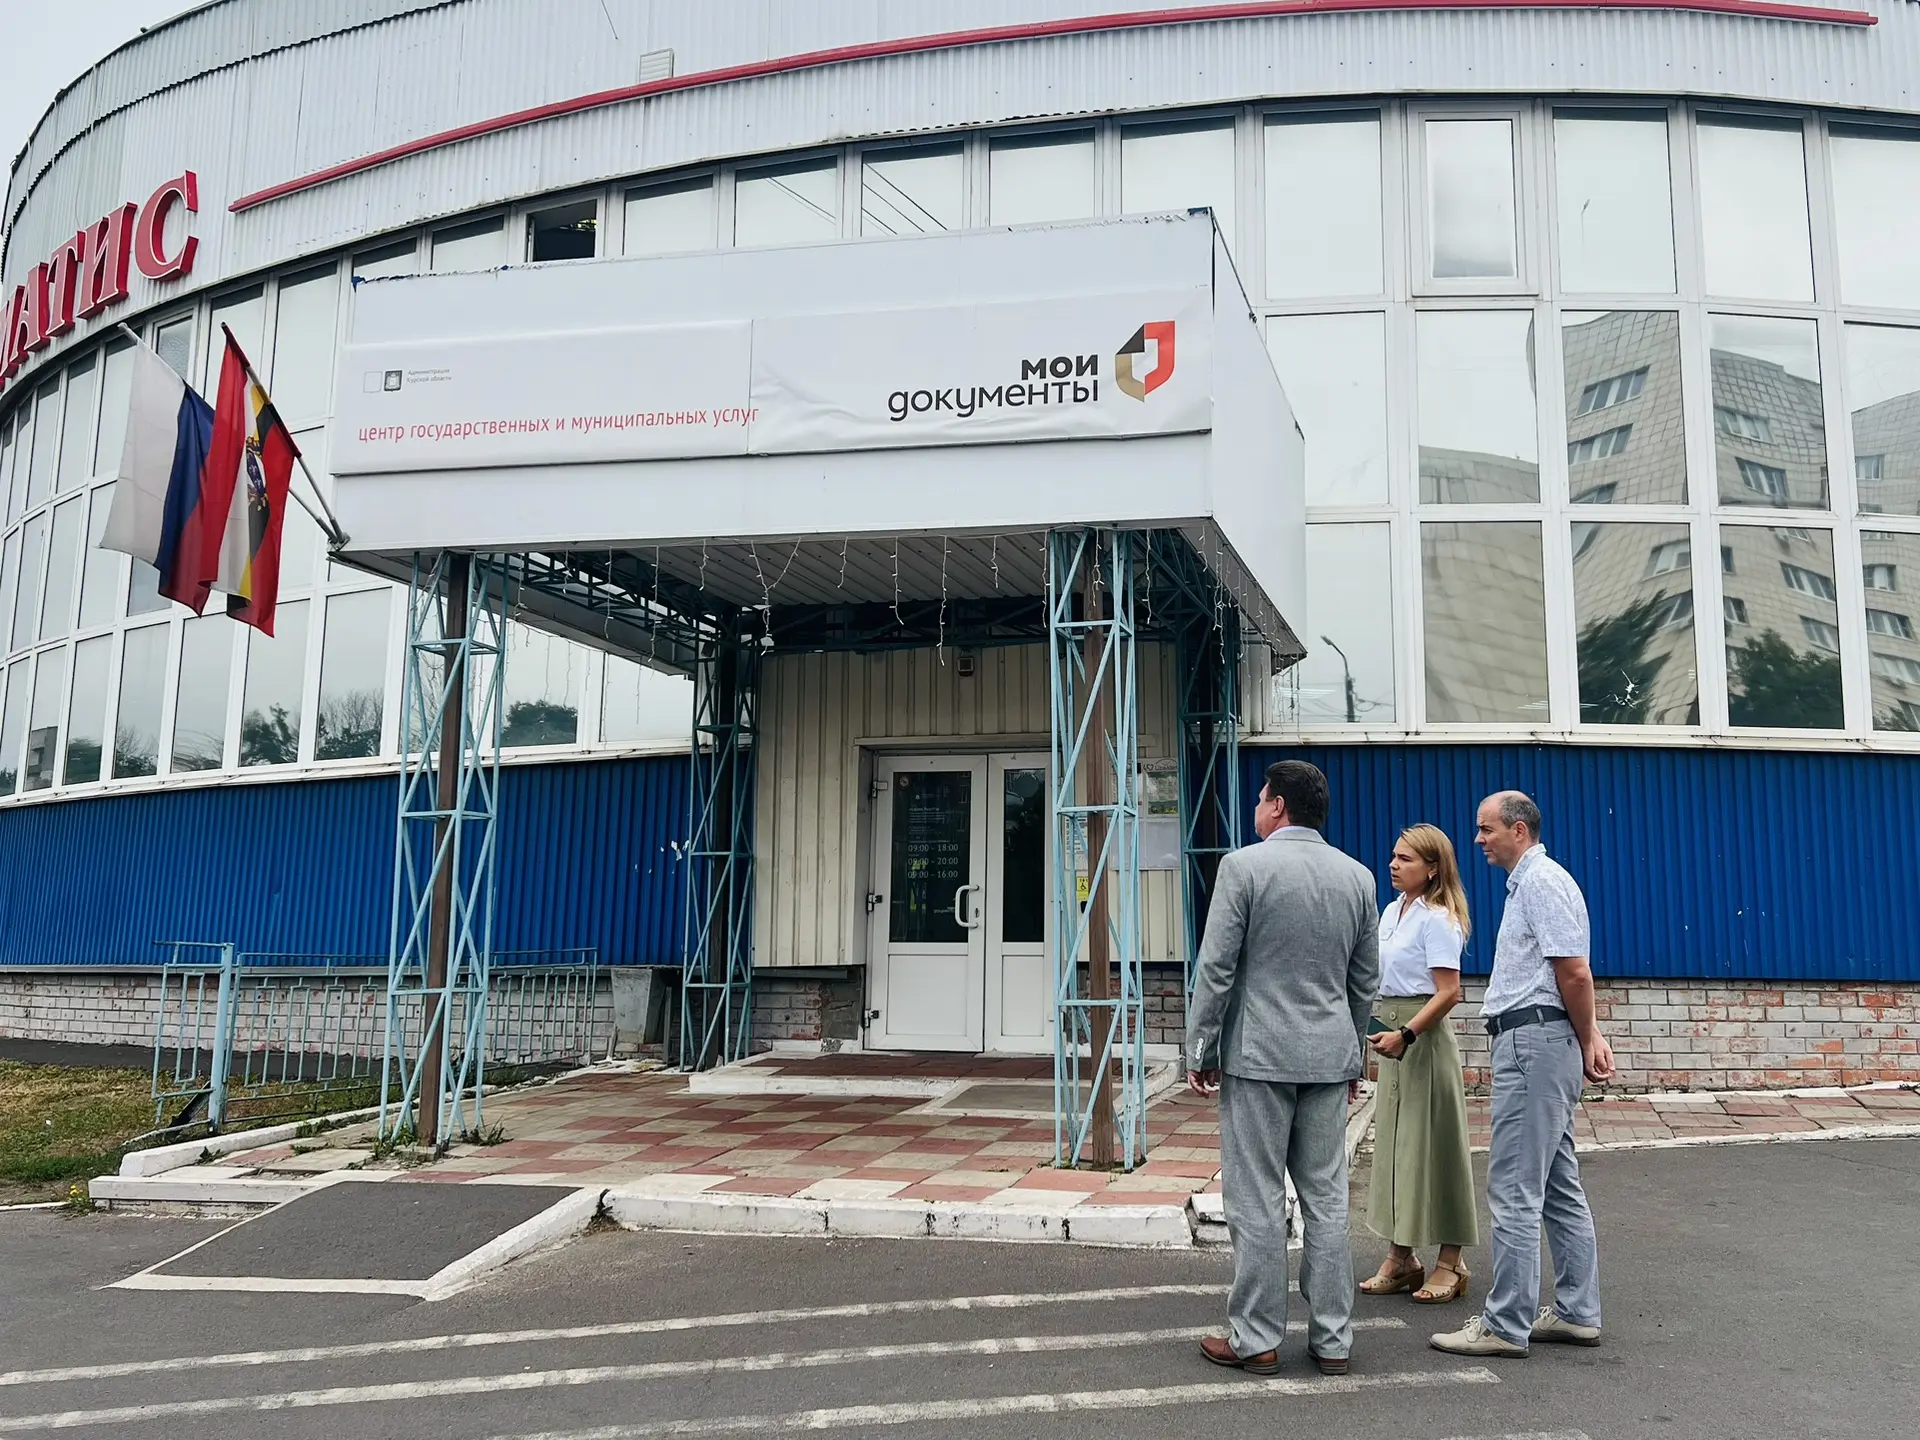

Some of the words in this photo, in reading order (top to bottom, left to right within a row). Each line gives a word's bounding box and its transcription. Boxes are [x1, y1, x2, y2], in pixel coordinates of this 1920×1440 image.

[888, 379, 1099, 421] документы
[359, 425, 404, 443] центр
[410, 418, 550, 442] государственных
[555, 418, 565, 431] и
[571, 409, 707, 434] муниципальных
[713, 408, 759, 428] услуг
